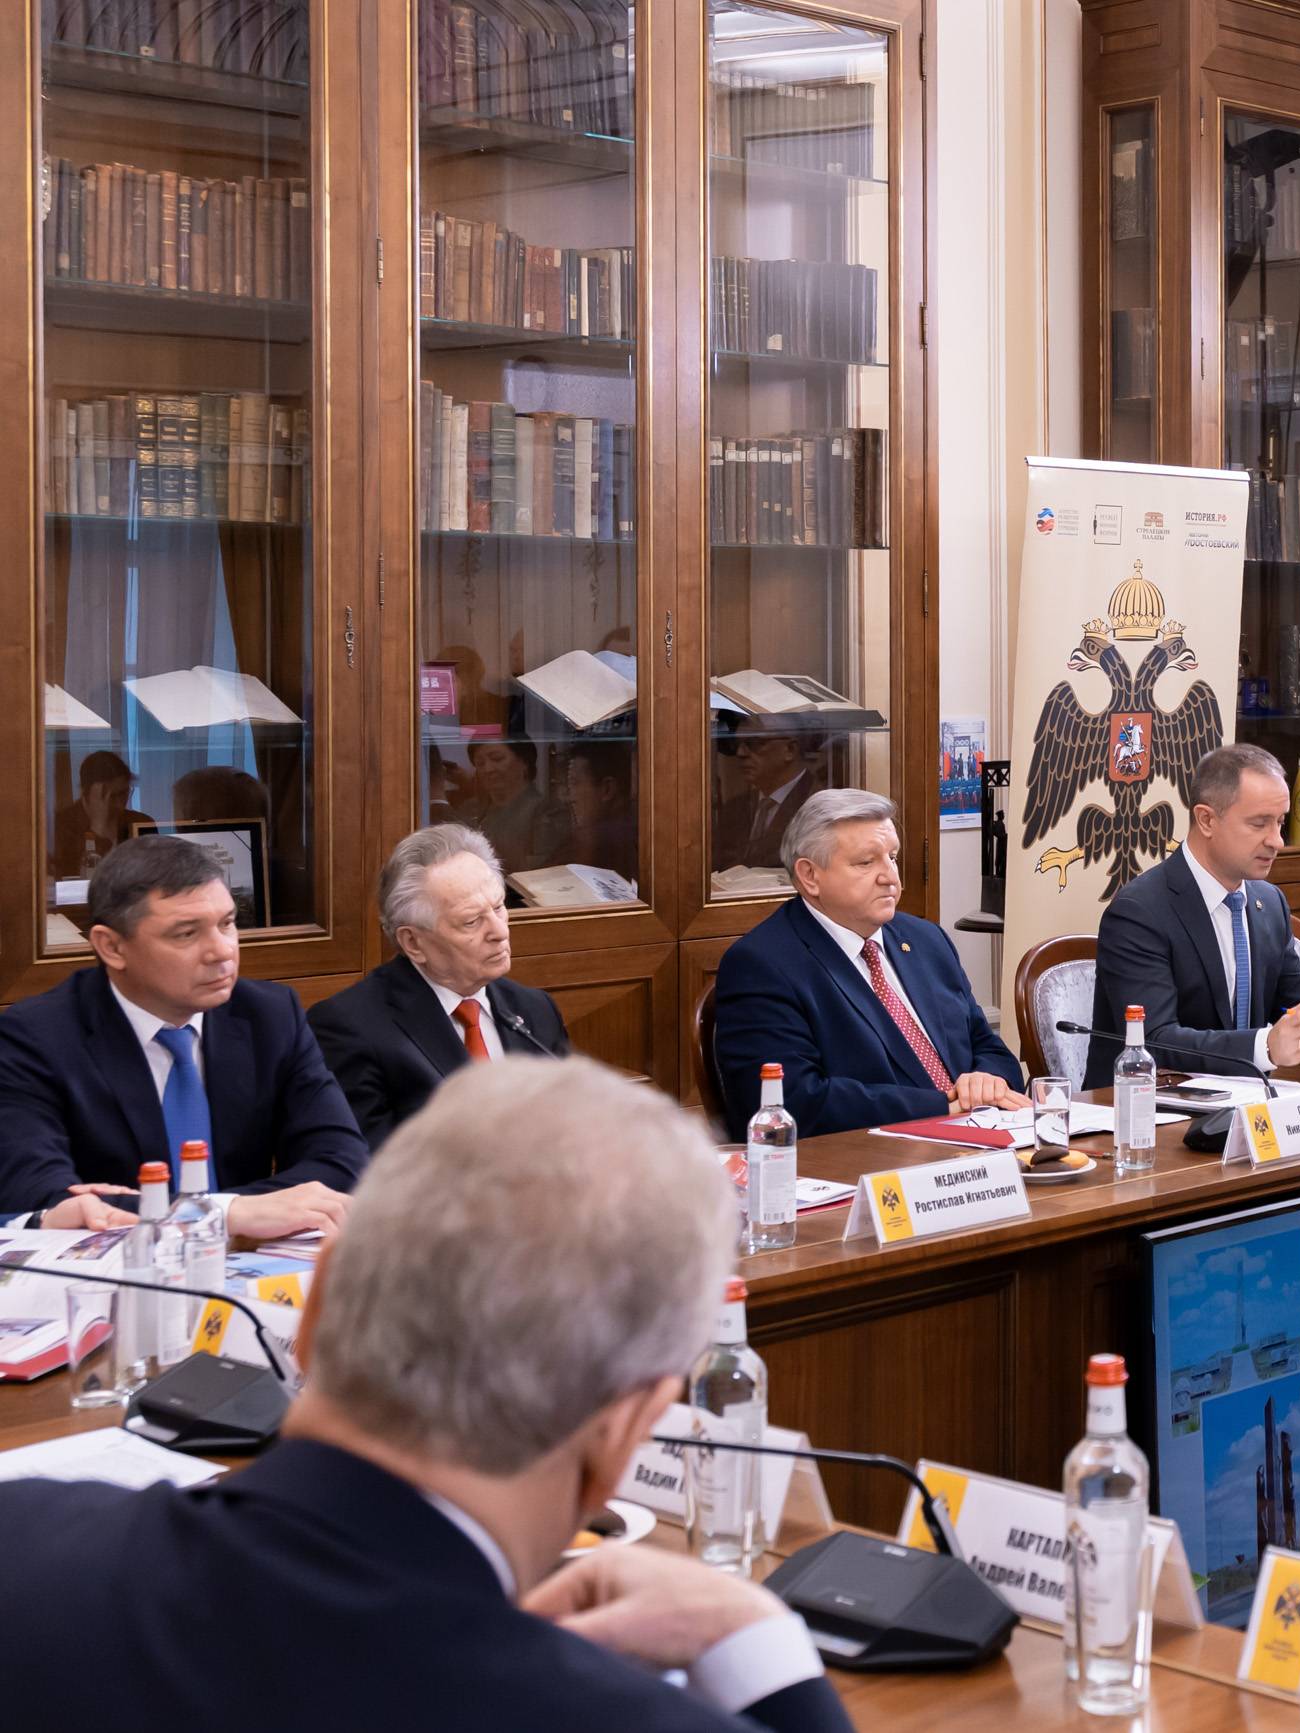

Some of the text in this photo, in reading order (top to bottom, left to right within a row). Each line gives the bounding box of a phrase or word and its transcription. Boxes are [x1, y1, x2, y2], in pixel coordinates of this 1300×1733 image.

[1185, 512, 1227, 522] ИСТОРИЯ.РФ
[934, 1165, 989, 1188] МЕДИНСКИЙ
[914, 1184, 1018, 1214] Ростислав Игнатьевич
[634, 1464, 678, 1491] Вадим
